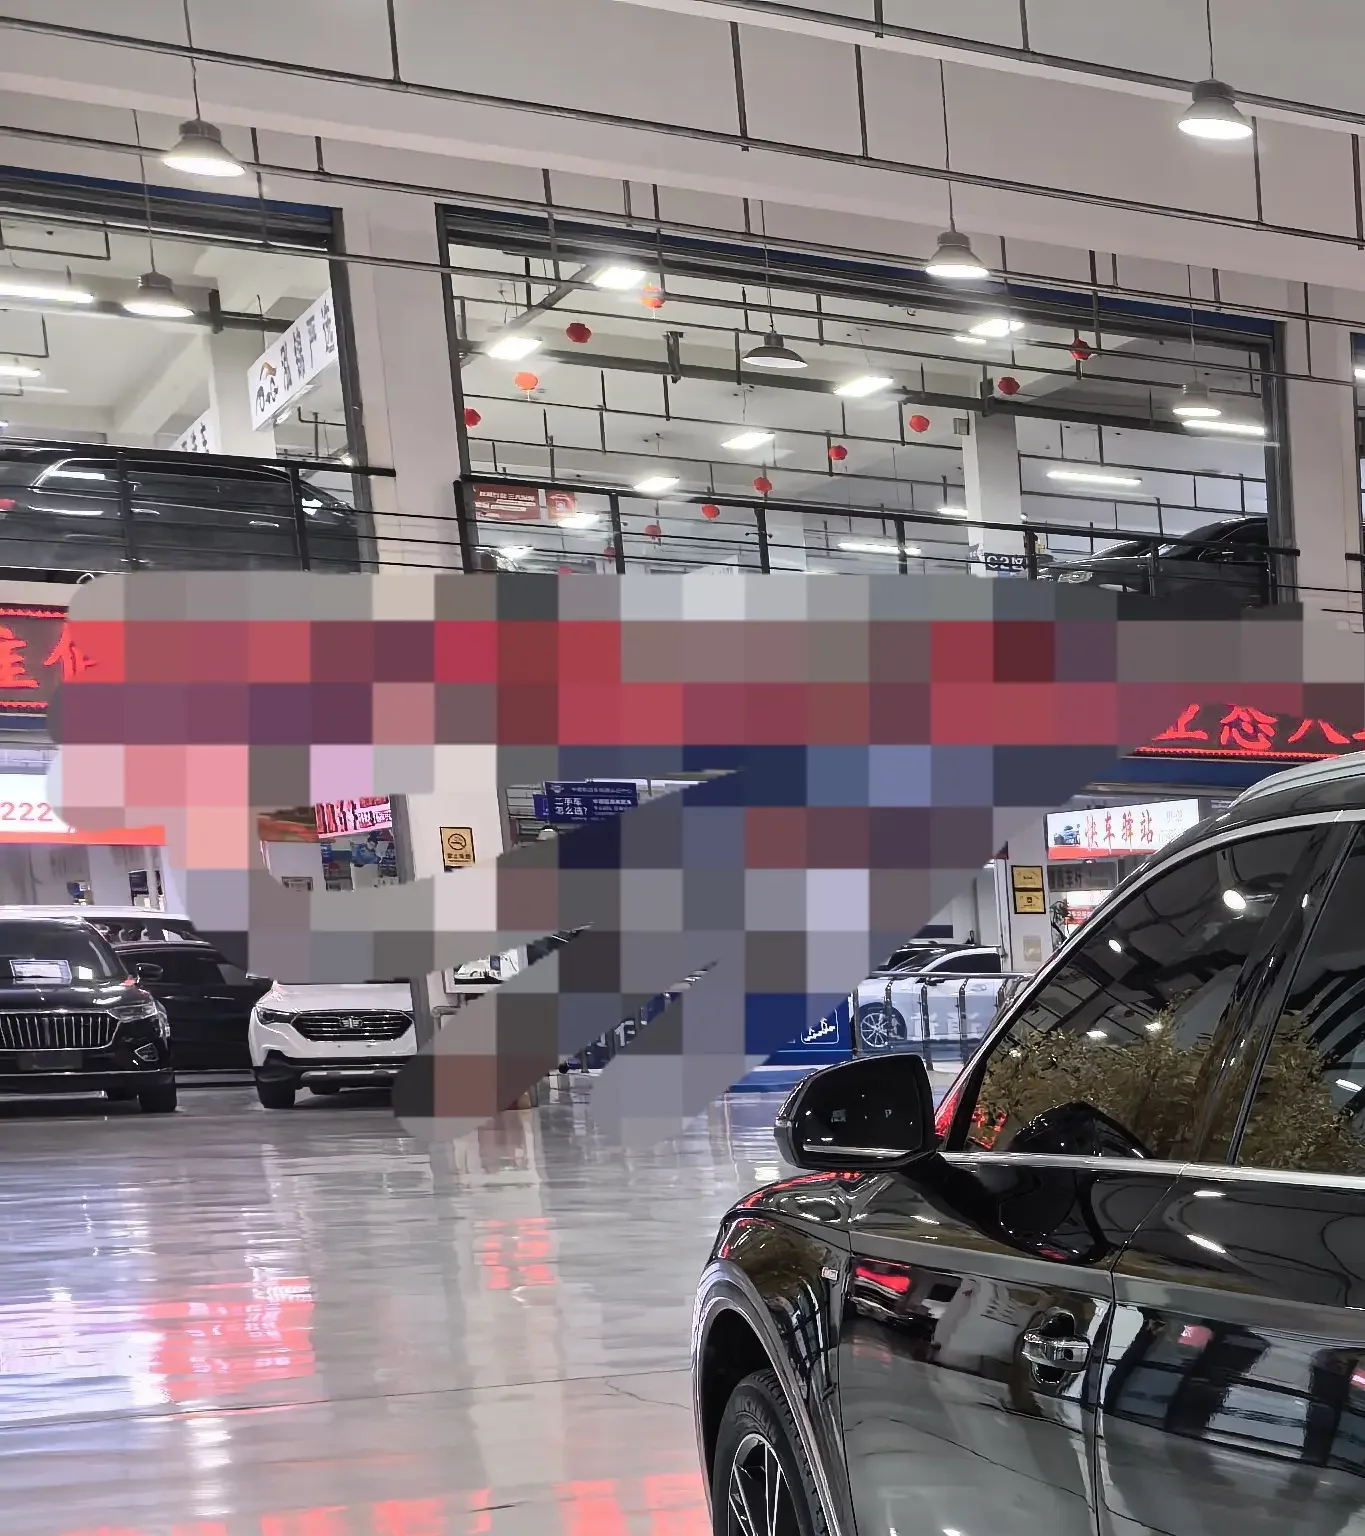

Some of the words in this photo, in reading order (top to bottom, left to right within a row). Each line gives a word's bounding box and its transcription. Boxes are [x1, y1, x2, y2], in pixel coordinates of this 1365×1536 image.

[554, 797, 582, 806] 二手车
[0, 801, 53, 822] 222
